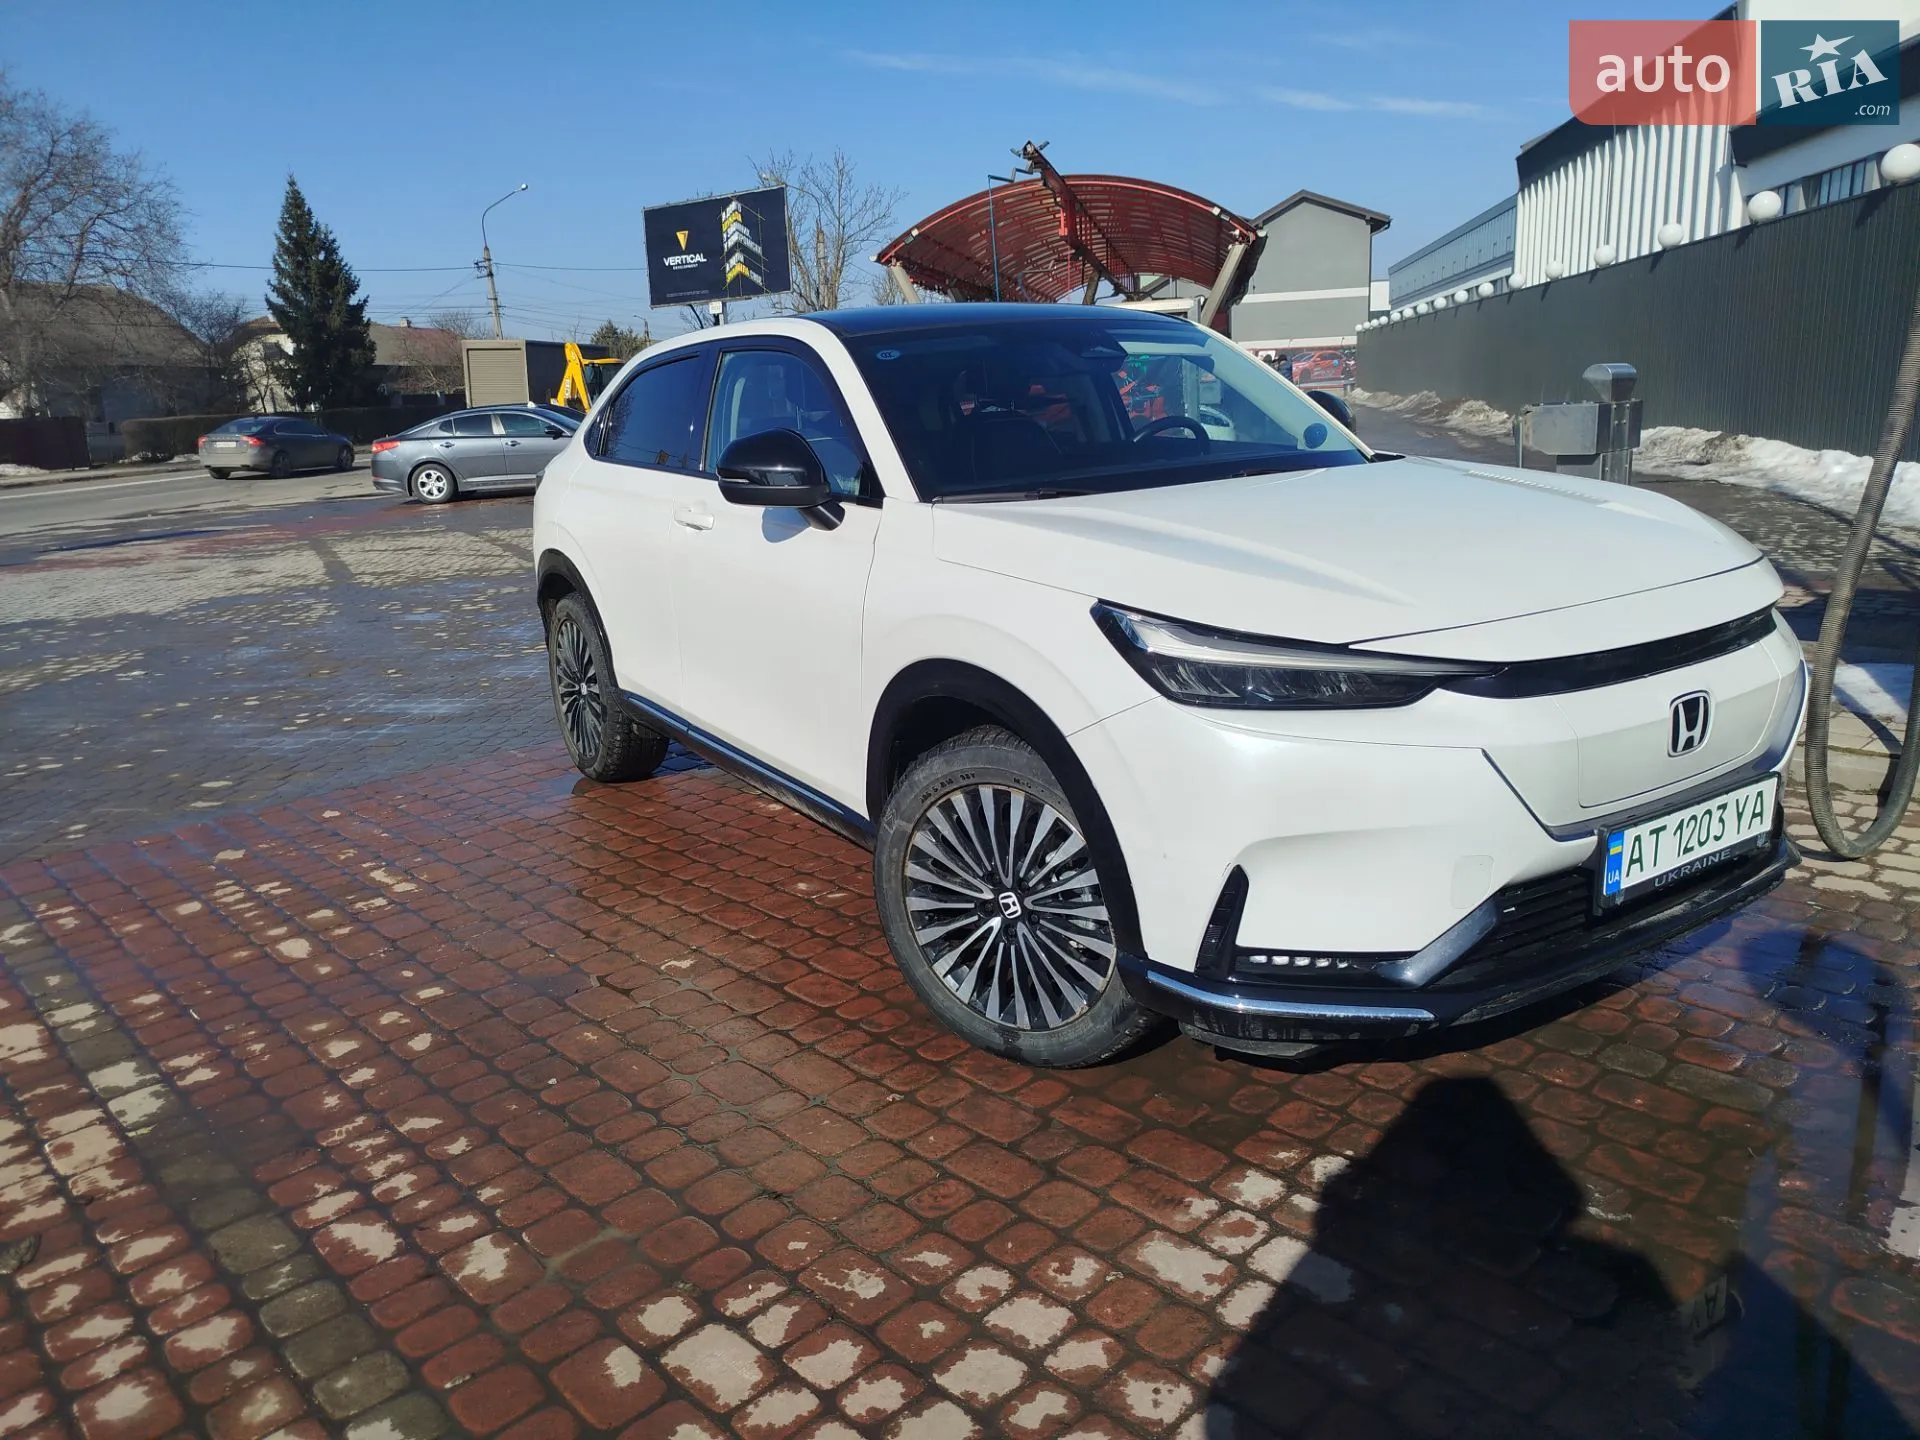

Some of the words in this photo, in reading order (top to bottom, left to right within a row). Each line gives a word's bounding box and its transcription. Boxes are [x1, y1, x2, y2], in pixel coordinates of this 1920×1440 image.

[663, 252, 707, 266] VERTICAL
[1625, 824, 1667, 878] AT
[1673, 802, 1728, 858] 1203
[1735, 790, 1764, 835] YA
[1608, 872, 1620, 884] UA
[1654, 848, 1732, 887] UKRAINE
